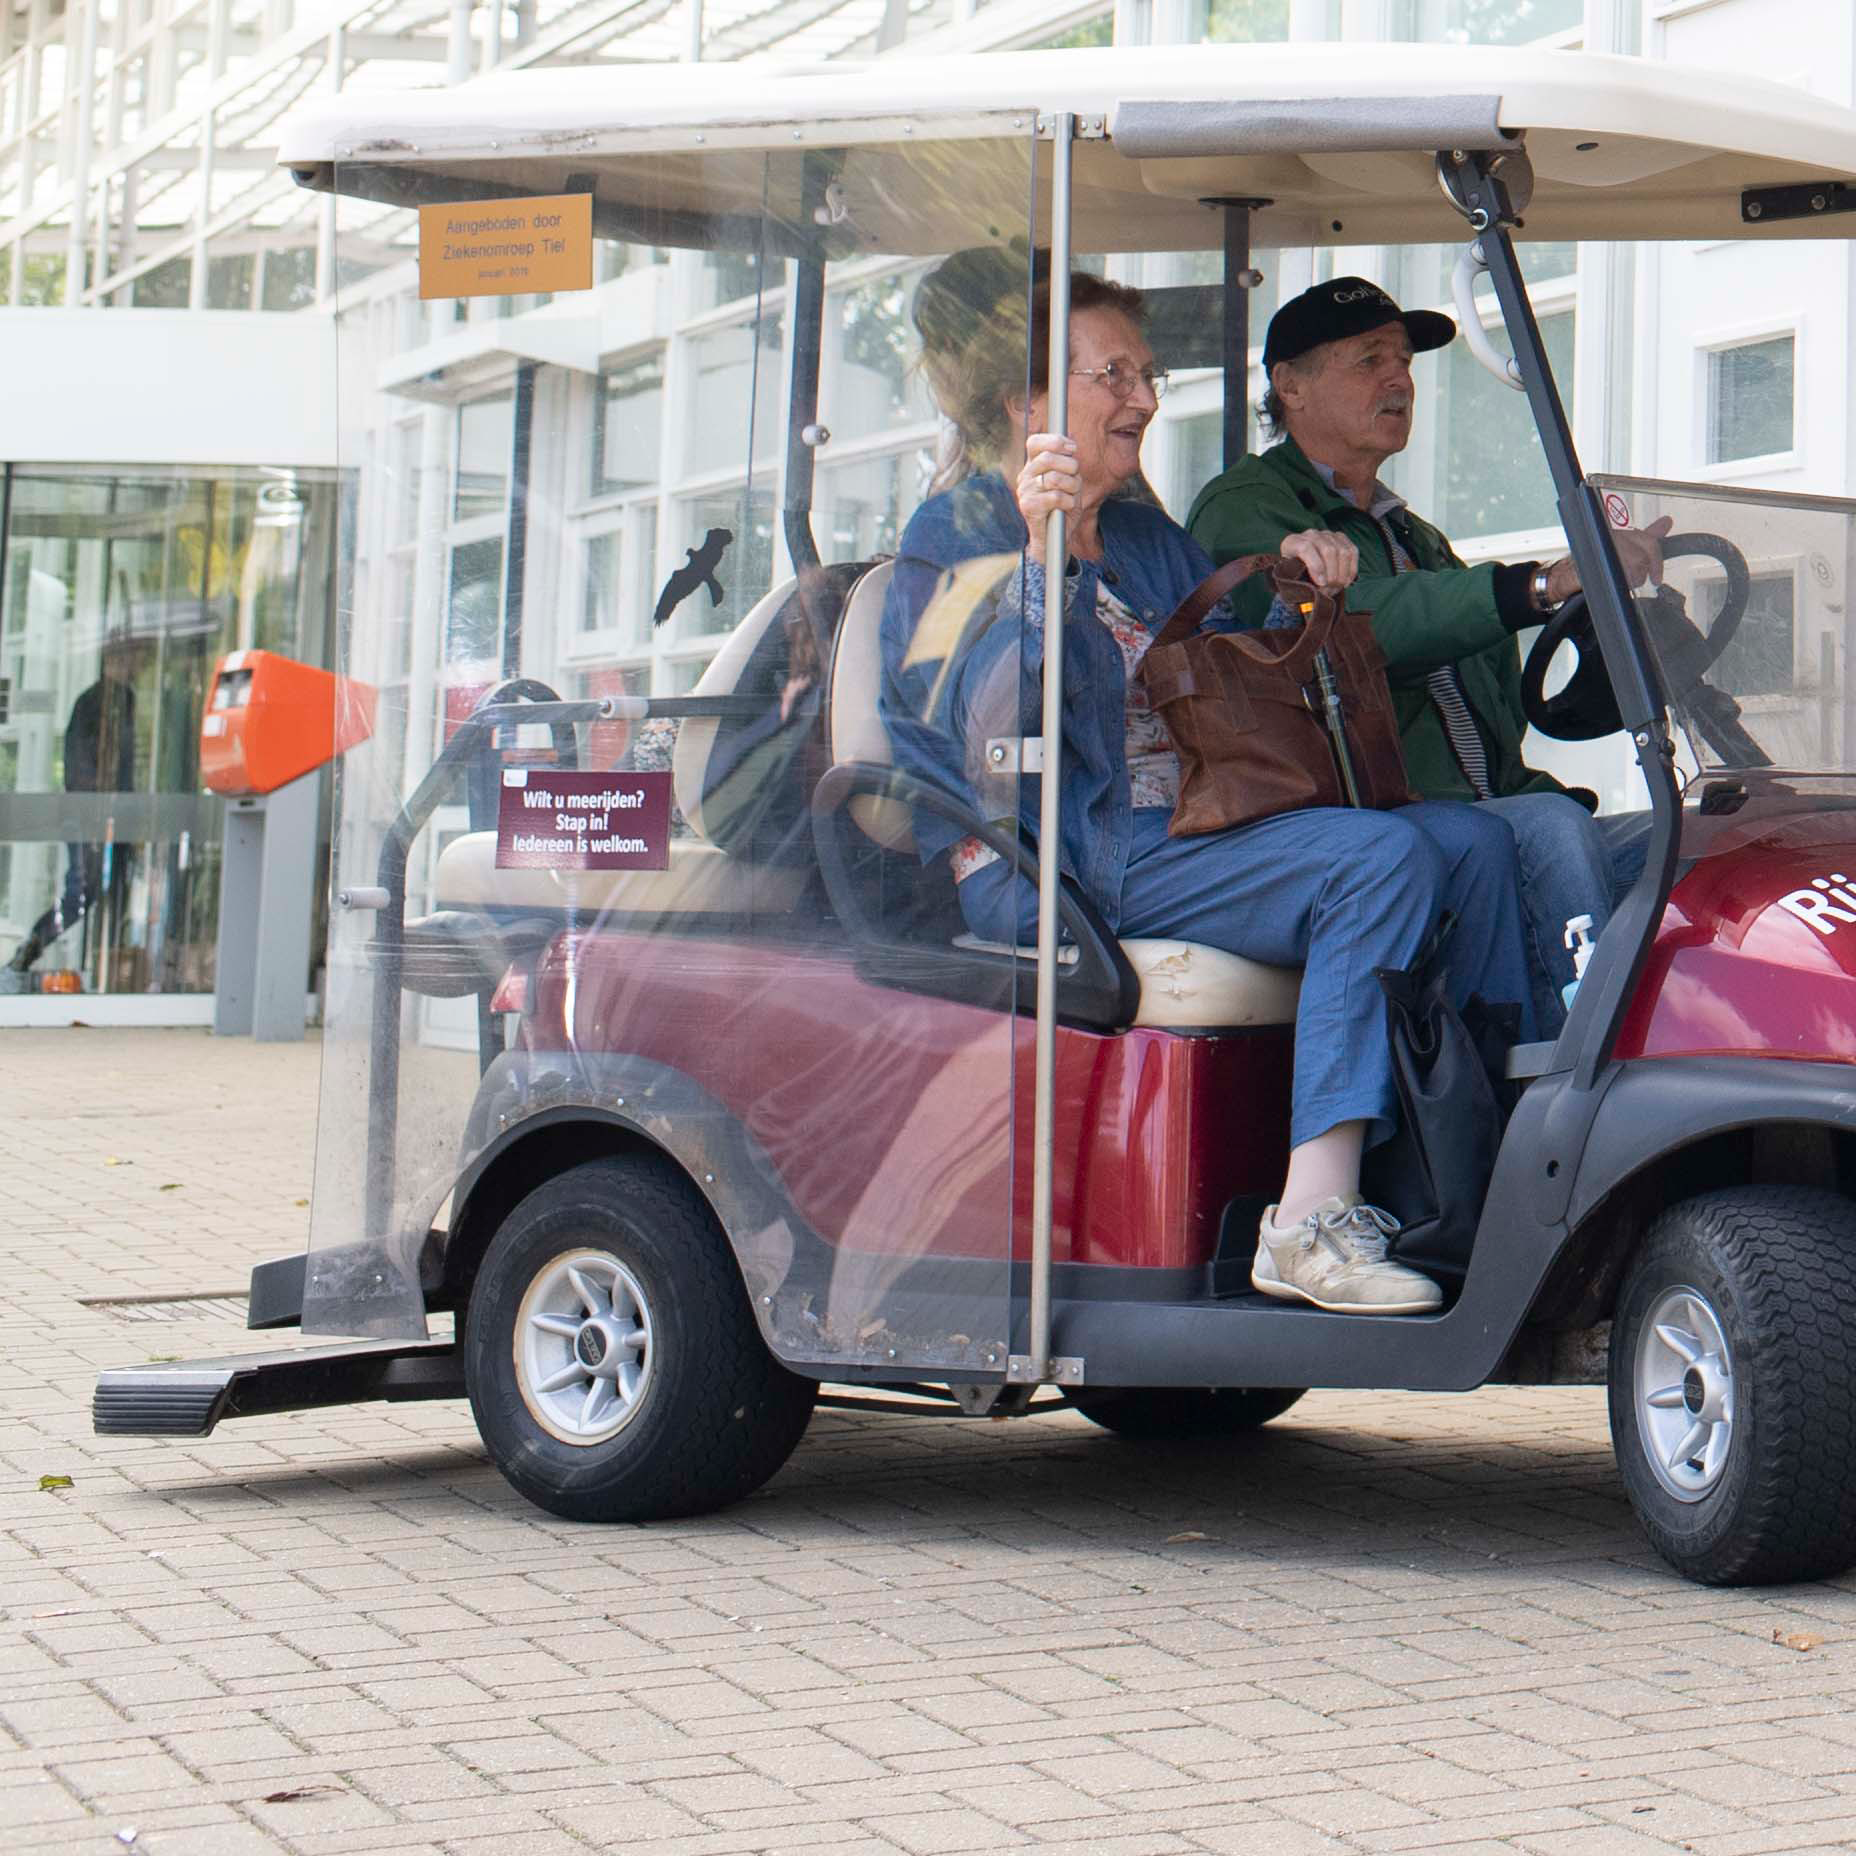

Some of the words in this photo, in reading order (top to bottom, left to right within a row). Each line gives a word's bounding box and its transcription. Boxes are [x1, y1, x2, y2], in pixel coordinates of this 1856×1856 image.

[446, 215, 526, 235] Aangeboden
[533, 213, 563, 229] door
[443, 240, 535, 261] Ziekenomroep
[542, 238, 566, 254] Tiel
[523, 790, 552, 808] Wilt
[555, 795, 565, 809] u
[567, 790, 645, 811] meerijden?
[555, 813, 587, 833] Stap
[589, 813, 609, 831] in!
[513, 834, 573, 852] Iedereen
[576, 835, 588, 852] is
[590, 834, 649, 853] welkom.
